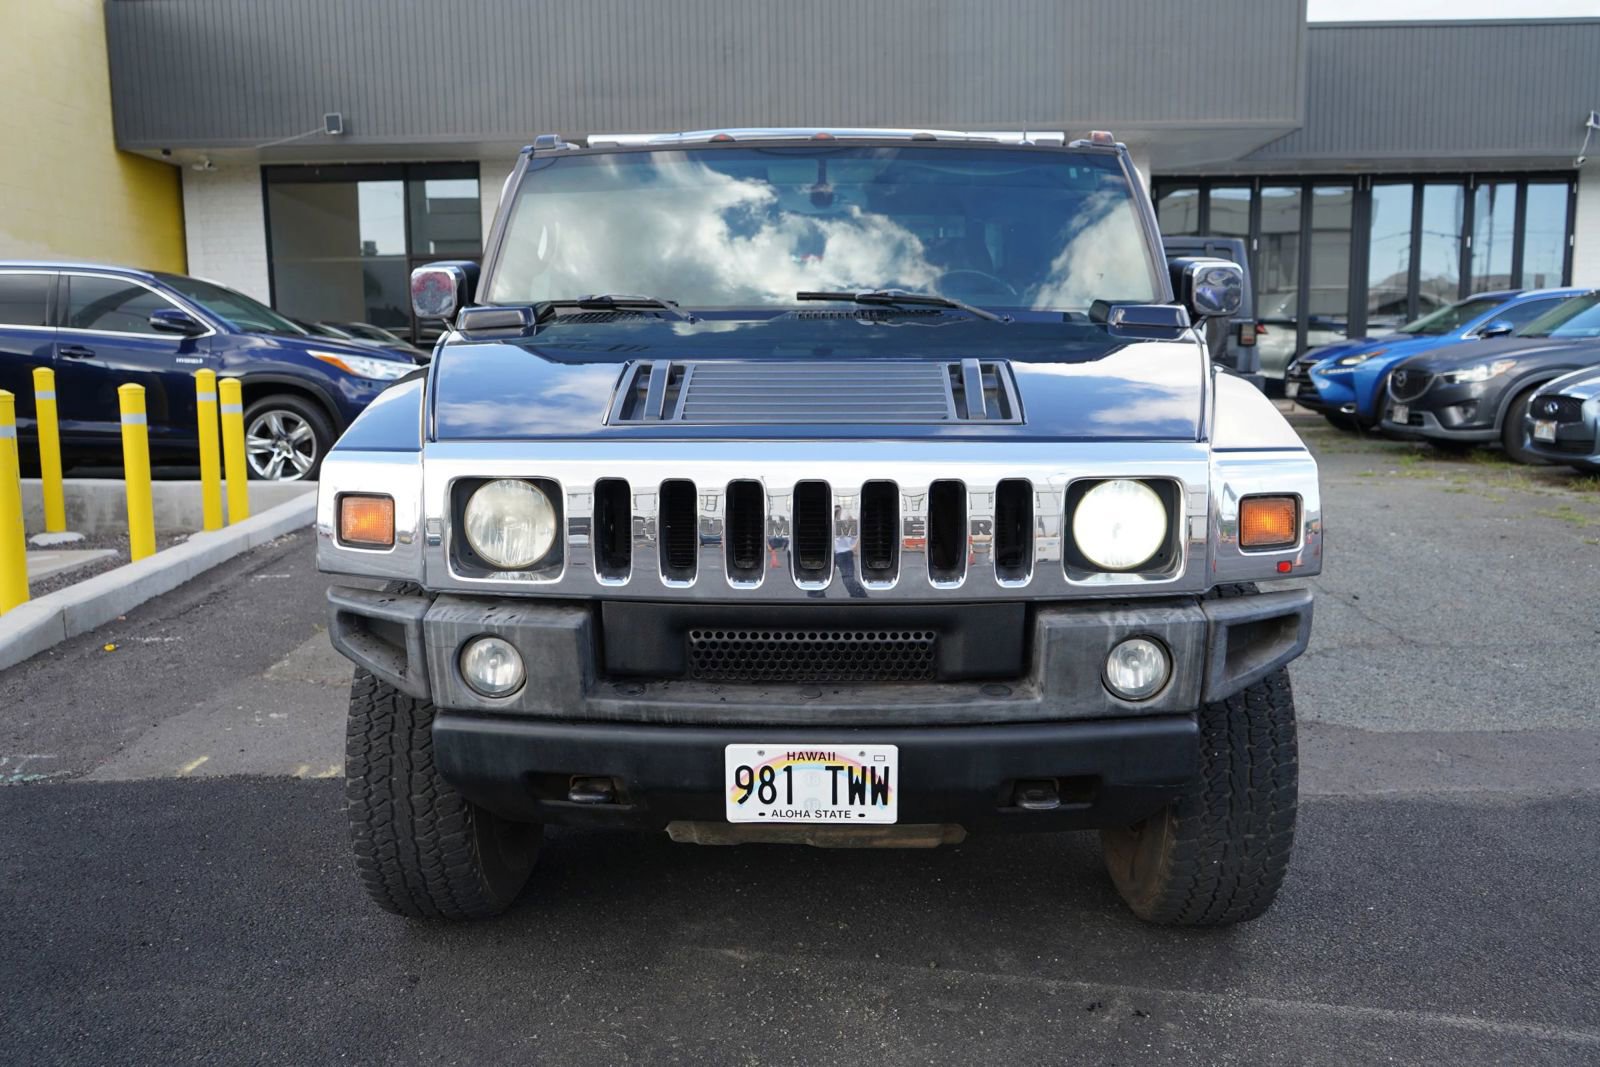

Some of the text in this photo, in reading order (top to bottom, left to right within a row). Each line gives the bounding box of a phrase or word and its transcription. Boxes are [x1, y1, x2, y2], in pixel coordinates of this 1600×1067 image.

[786, 751, 836, 761] HAWAII
[735, 765, 890, 805] 981 TWW
[771, 809, 852, 819] ALOHA STATE
